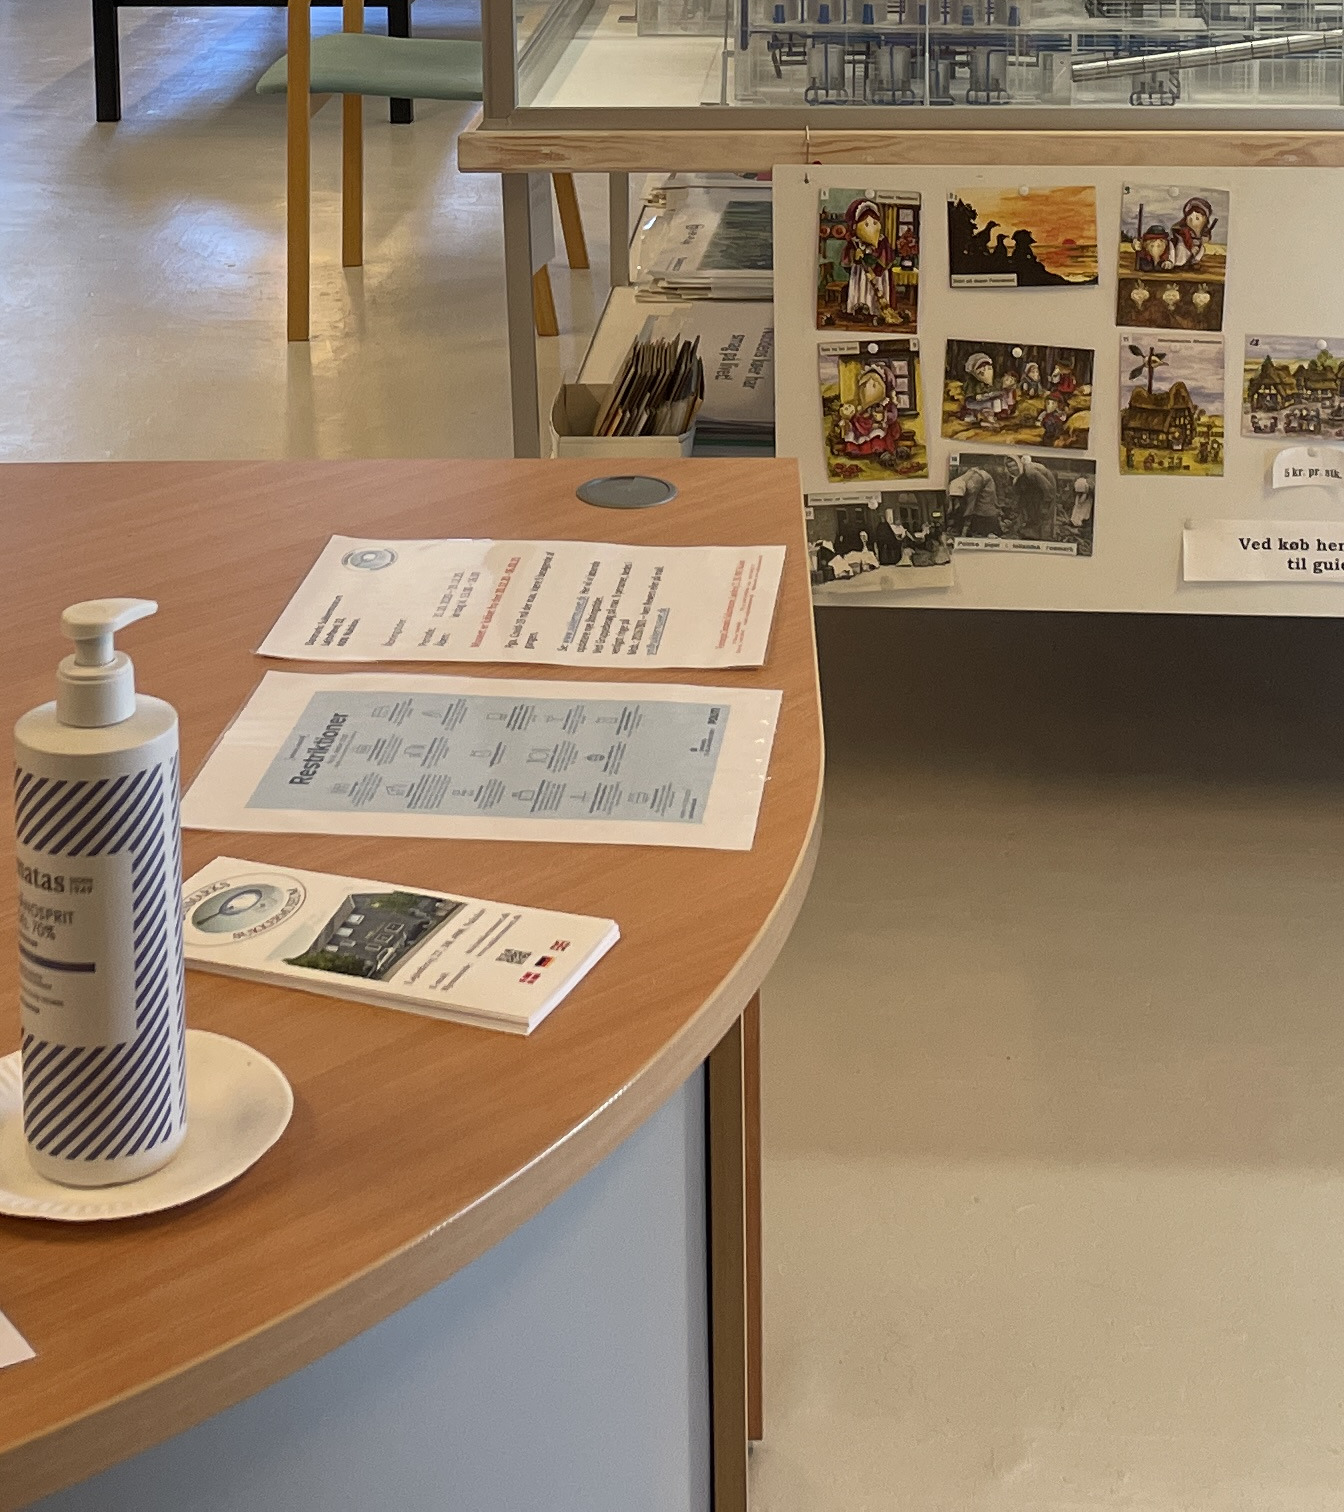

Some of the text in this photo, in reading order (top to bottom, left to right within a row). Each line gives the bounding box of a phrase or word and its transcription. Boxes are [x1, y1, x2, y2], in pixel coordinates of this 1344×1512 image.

[1308, 469, 1322, 480] pr.
[1239, 537, 1272, 552] Ved
[1277, 538, 1311, 553] køb
[1287, 557, 1307, 570] til
[289, 712, 348, 787] Restriktioner
